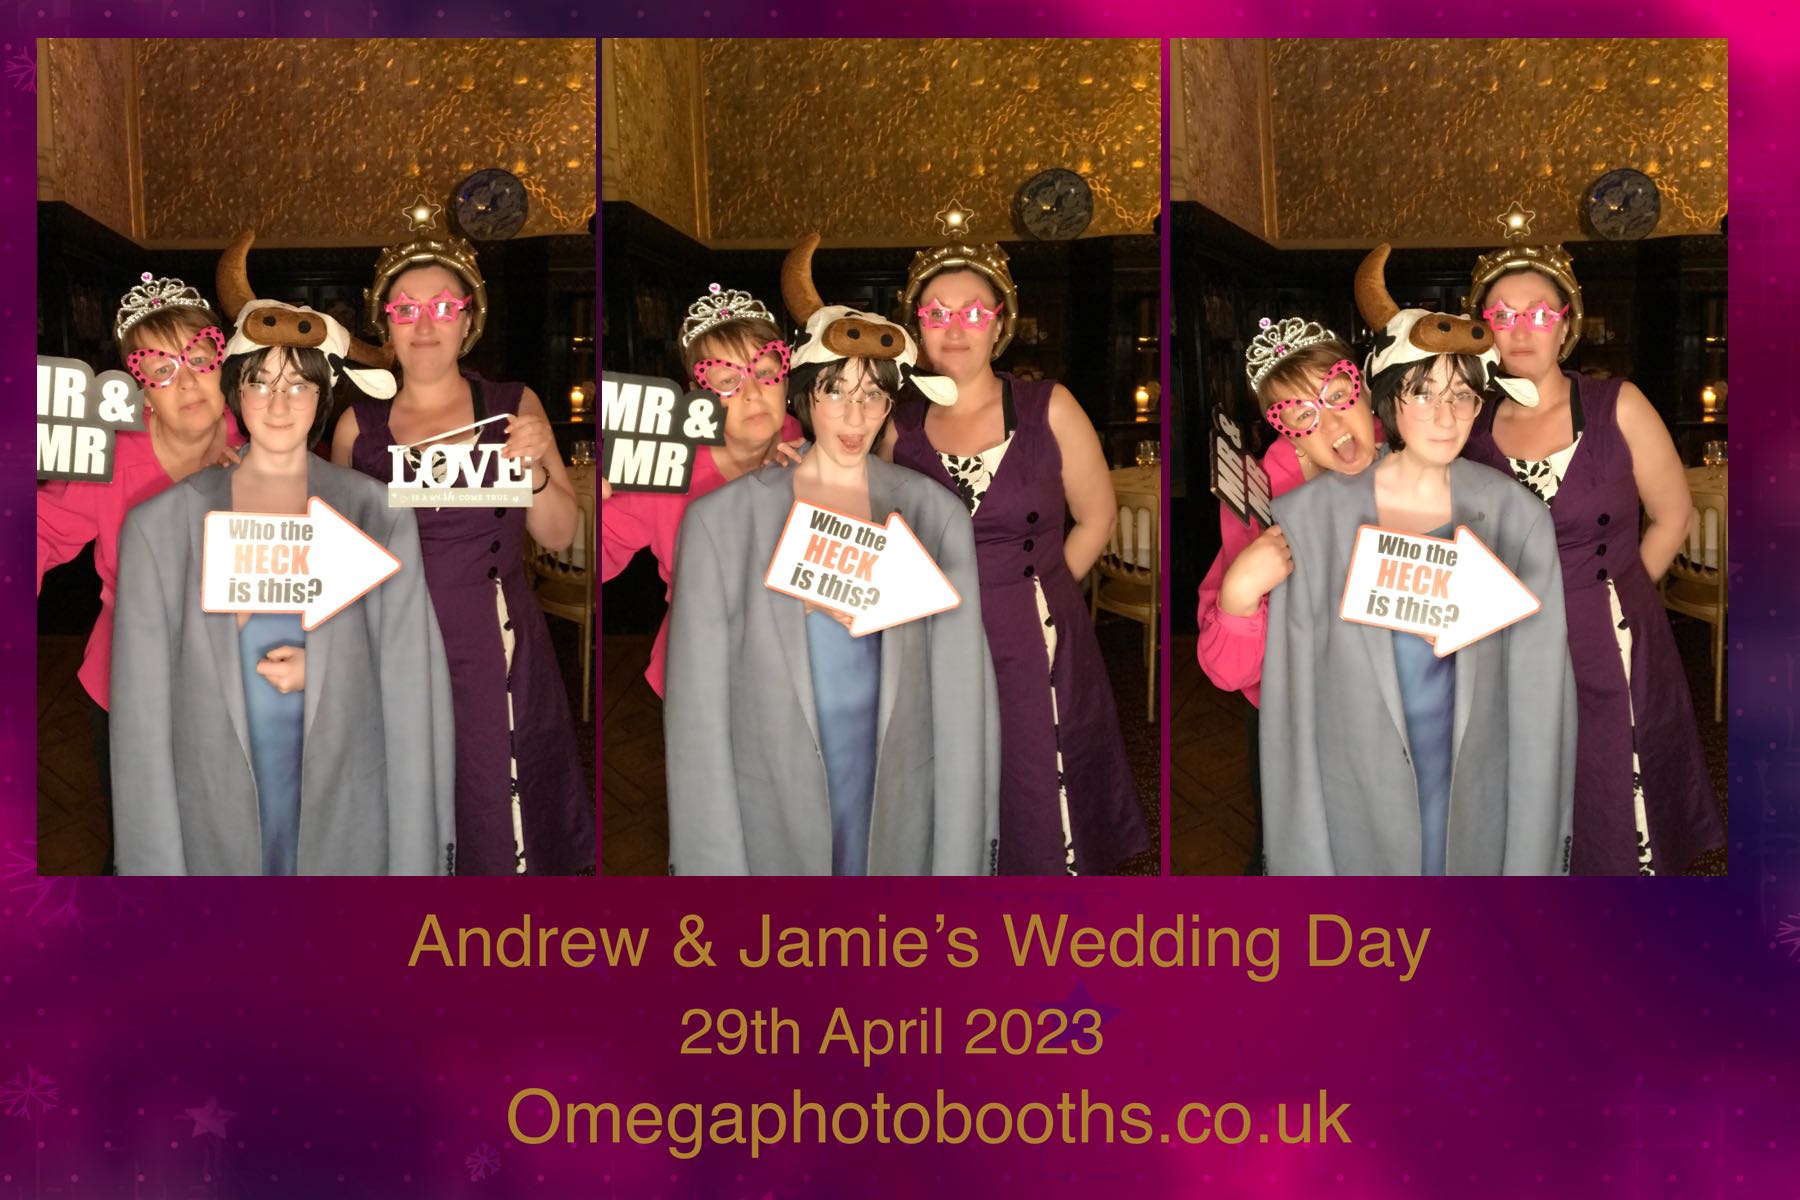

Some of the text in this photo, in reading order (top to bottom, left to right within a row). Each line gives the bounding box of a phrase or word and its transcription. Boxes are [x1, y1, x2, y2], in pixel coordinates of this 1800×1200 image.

[99, 380, 135, 422] &
[602, 381, 718, 439] MR &
[37, 423, 107, 474] MR
[388, 444, 532, 488] LOVE
[608, 438, 688, 487] MR
[1217, 413, 1246, 515] MR &
[459, 493, 483, 502] COME
[486, 493, 508, 502] TRUE
[1246, 455, 1271, 526] MR
[229, 519, 314, 541] Who the
[810, 510, 887, 551] Who the
[1378, 534, 1458, 566] Who the
[234, 544, 312, 575] HECK
[803, 534, 879, 582] HECK
[1376, 559, 1453, 599] HECK
[229, 578, 322, 603] is this?
[790, 563, 880, 610] is this?
[1366, 590, 1459, 629] is this?
